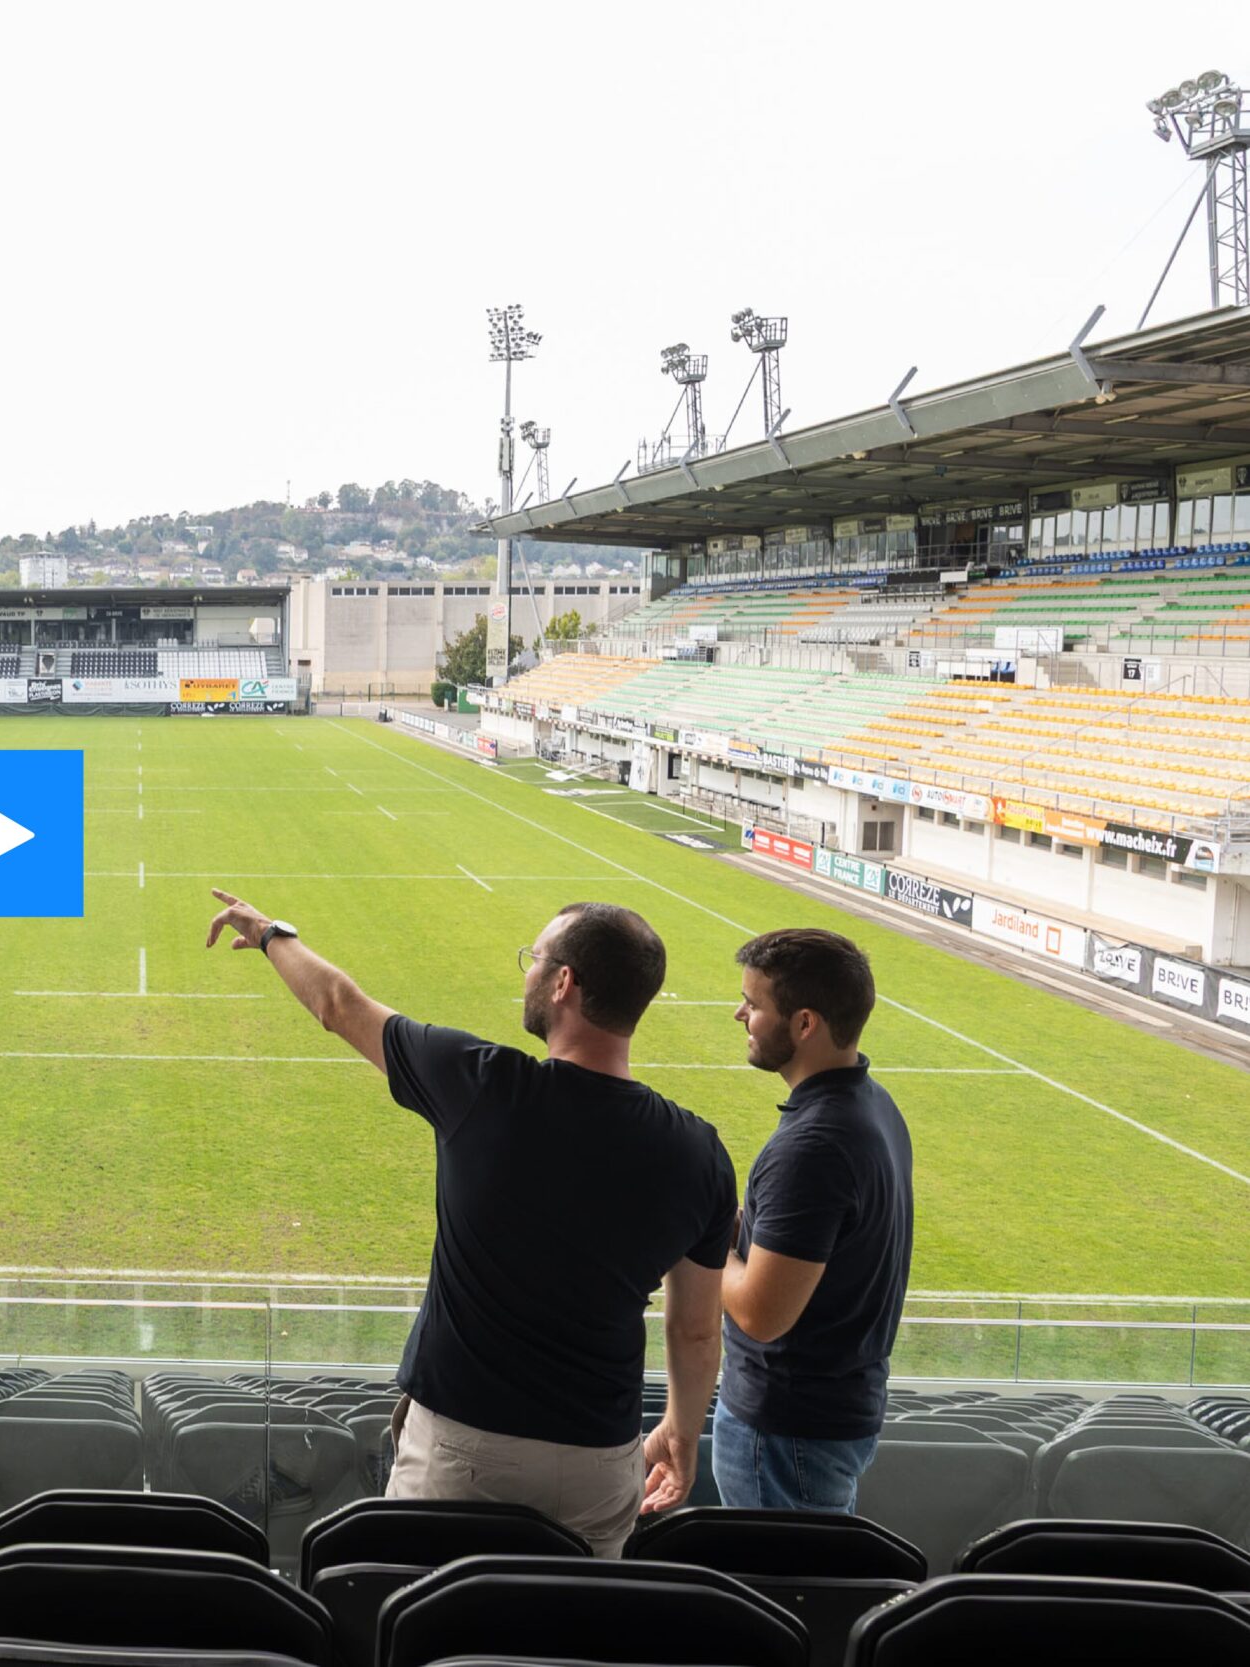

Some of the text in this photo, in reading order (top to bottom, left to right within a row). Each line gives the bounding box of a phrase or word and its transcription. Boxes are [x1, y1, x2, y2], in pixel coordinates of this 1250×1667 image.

[1086, 827, 1178, 858] www.macheix.fr
[834, 856, 861, 871] CENTRE
[833, 867, 860, 885] FRANCE
[888, 889, 896, 899] LE
[992, 908, 1039, 939] Jardiland
